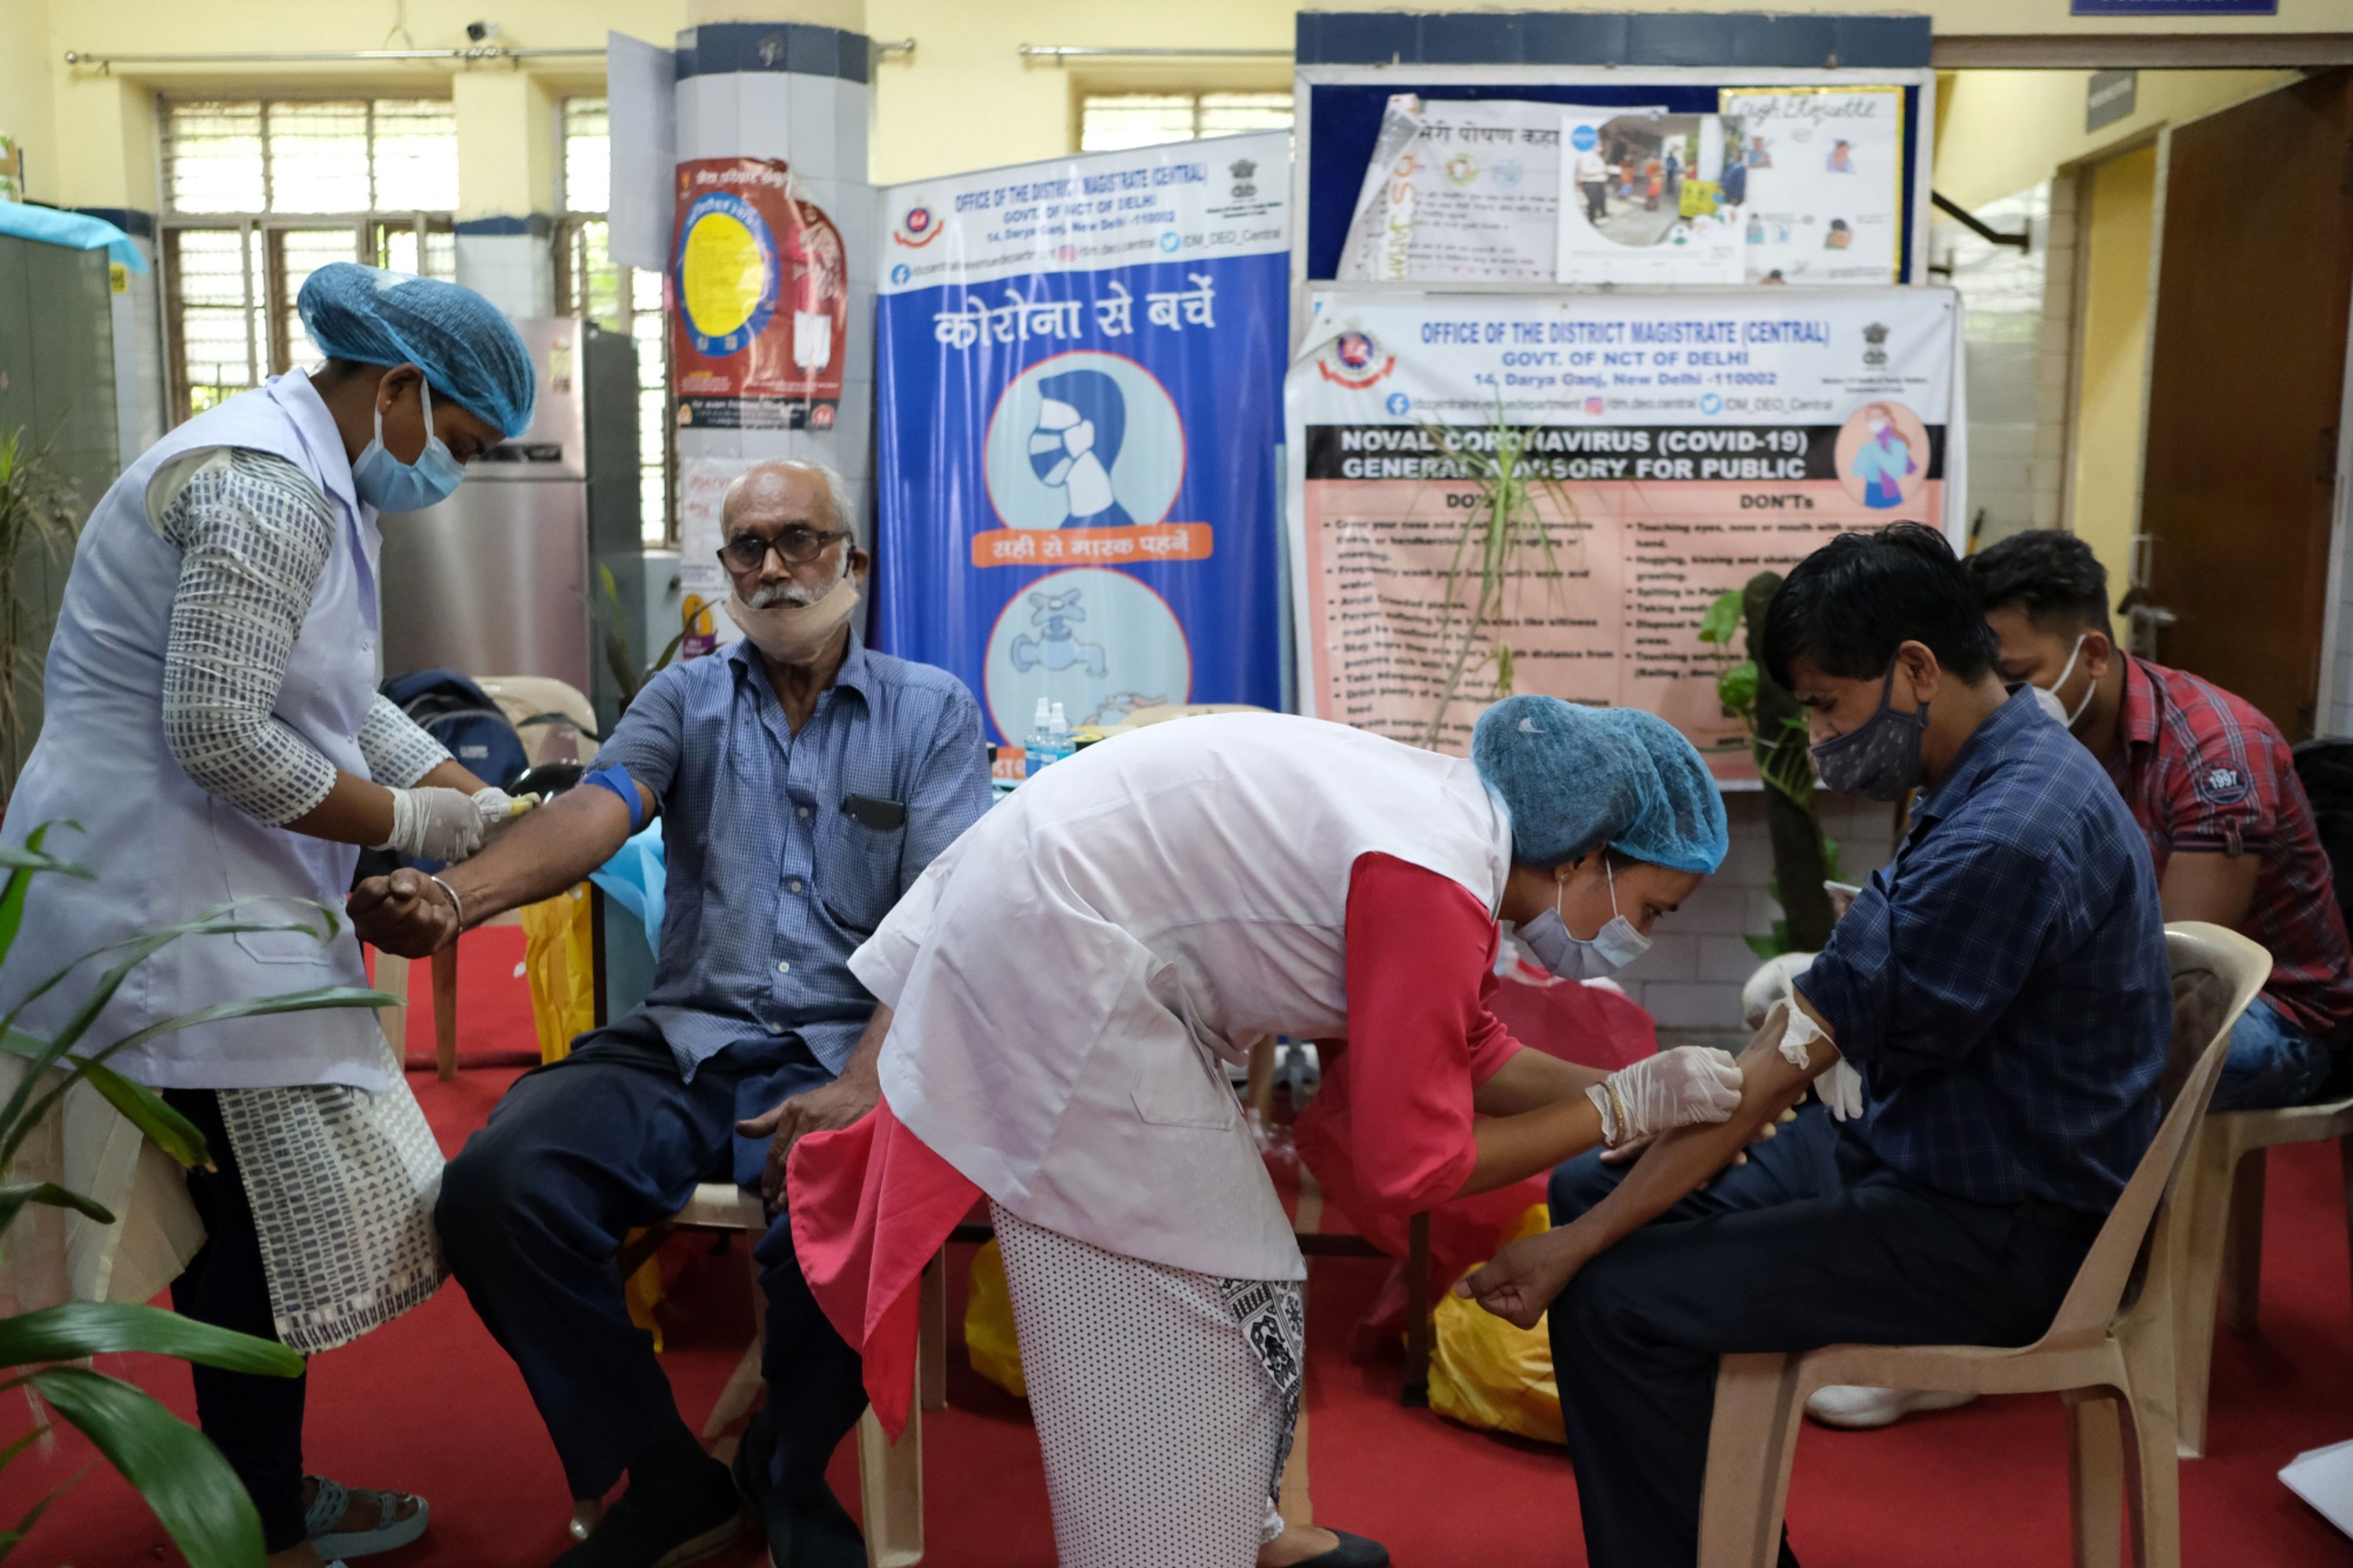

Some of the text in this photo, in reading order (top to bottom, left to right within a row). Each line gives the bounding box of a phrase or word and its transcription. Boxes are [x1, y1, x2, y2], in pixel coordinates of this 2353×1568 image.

[1521, 128, 1560, 148] कहा
[955, 191, 990, 213] OFFICE
[994, 188, 1006, 206] OF
[1009, 185, 1028, 203] THE
[1032, 178, 1080, 200] DISTRIC
[1096, 199, 1112, 213] OF
[933, 272, 1216, 349] कोरोना से बचें
[1421, 321, 1831, 346] OFFICE OF THE DISTRICT MAGISTRATE (CENTRAL)
[1502, 351, 1749, 366] GOVT. OF NCT OF DELHI
[1474, 372, 1777, 388] 14, Darya Ganj, New Delhi -110002
[1341, 429, 1808, 455] NOVAL CORONAVIRUS (COVID-19)
[1634, 458, 1694, 479] FOR
[1700, 458, 1806, 479] PUBLIC
[1740, 495, 1814, 509] DON'Ts
[1636, 522, 1691, 535] Touching
